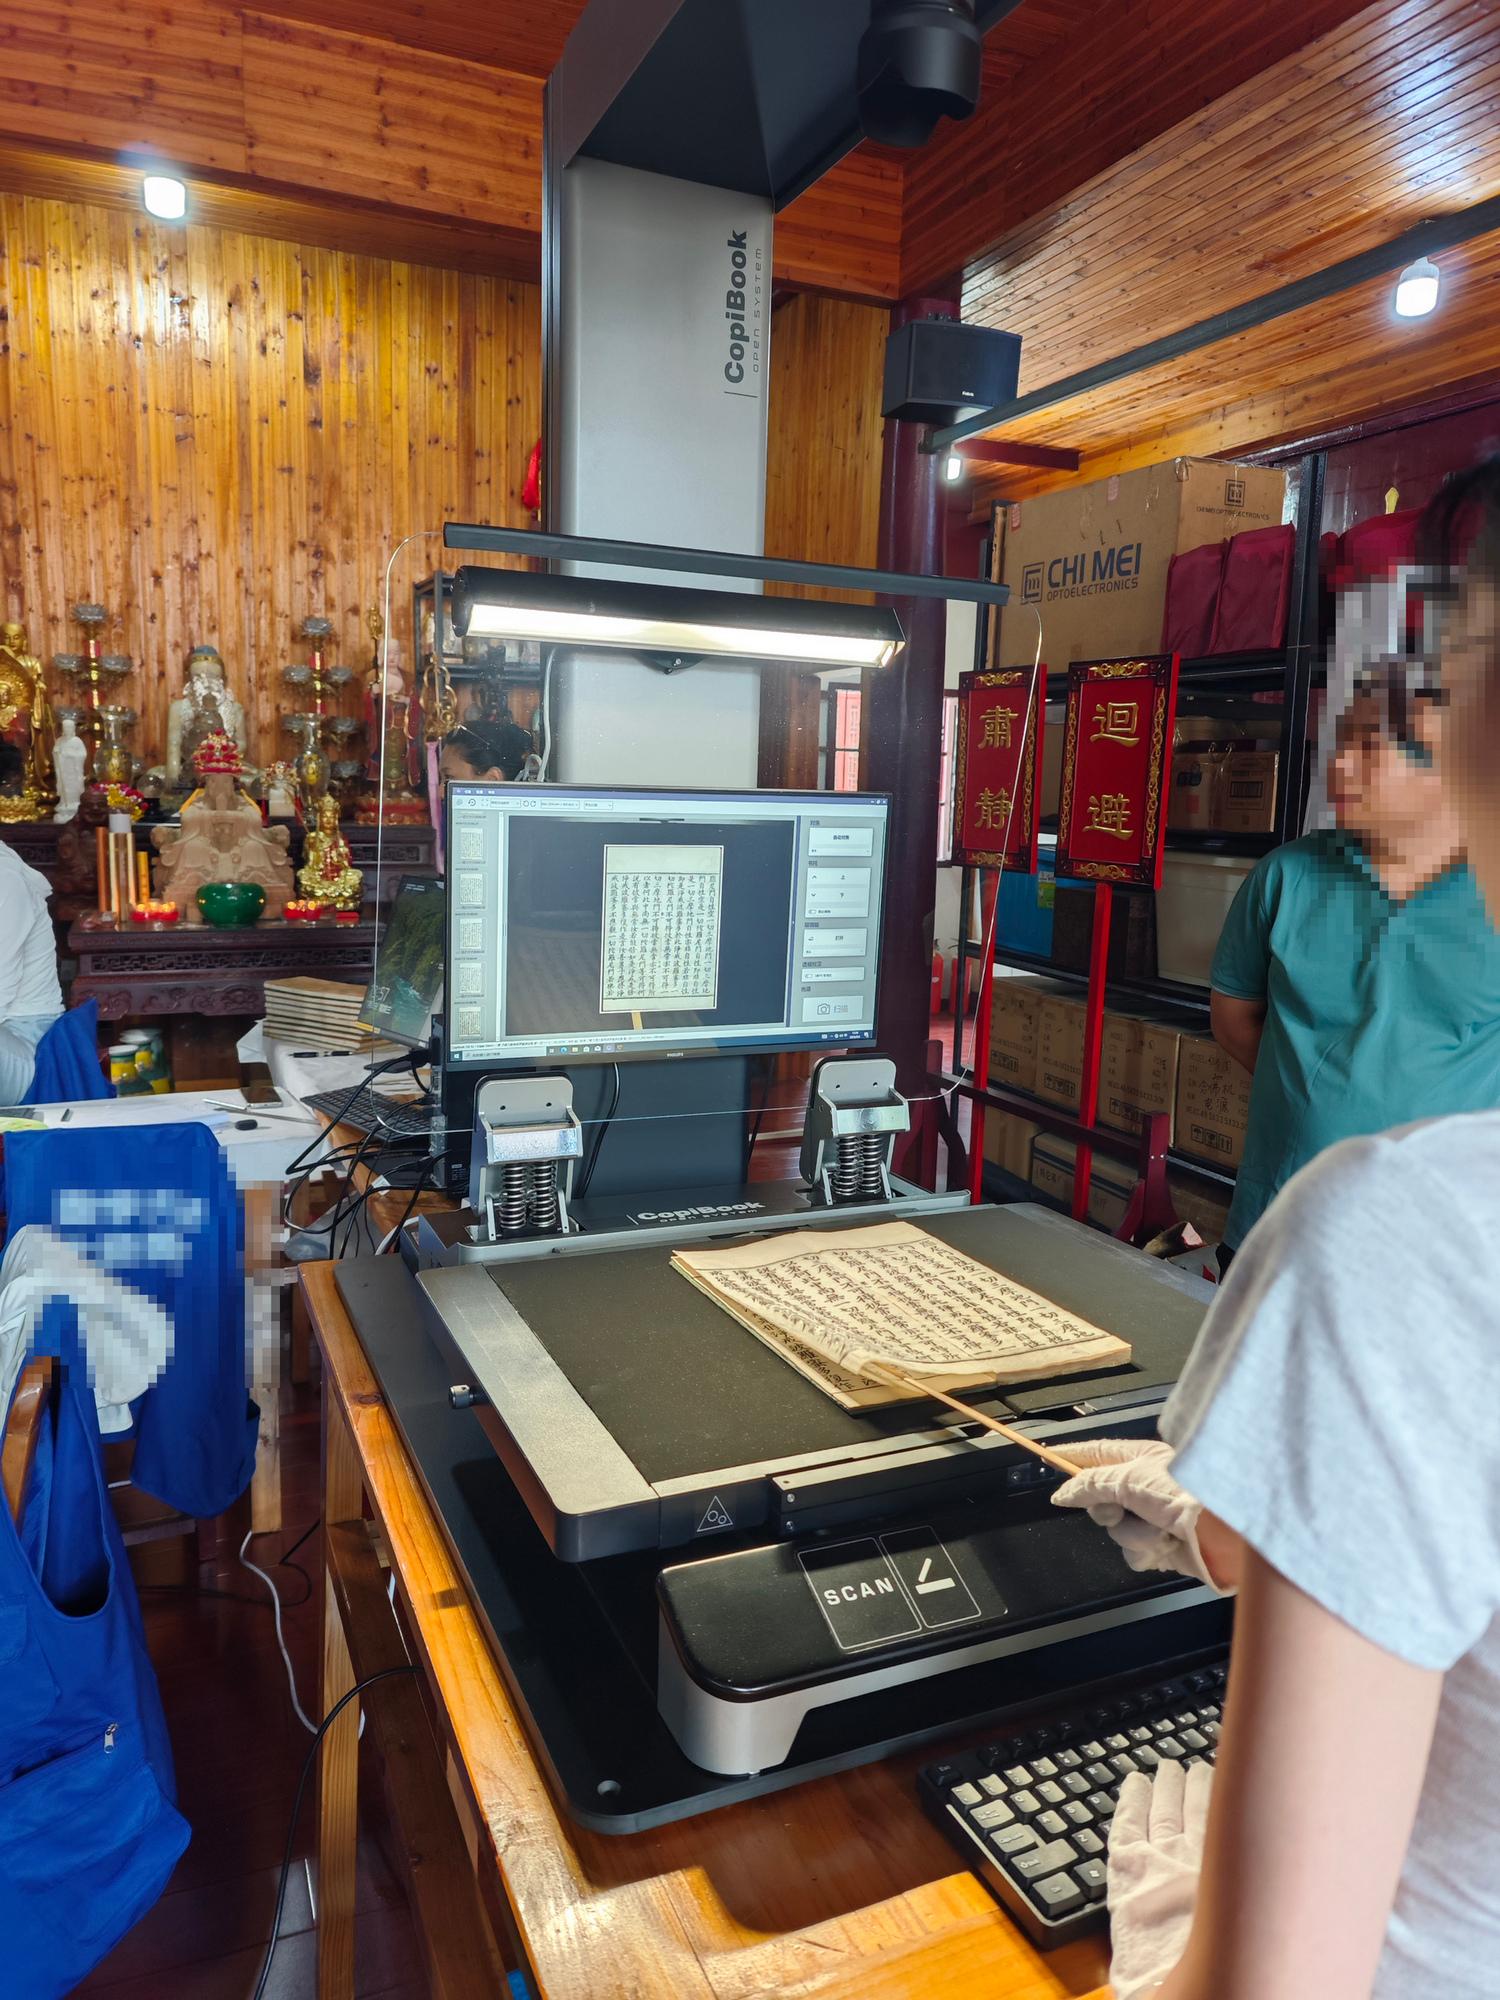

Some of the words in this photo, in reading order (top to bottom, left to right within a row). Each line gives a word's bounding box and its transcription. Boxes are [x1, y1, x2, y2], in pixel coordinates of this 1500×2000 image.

[724, 230, 750, 384] CopiBook
[1048, 552, 1086, 588] CHI
[1091, 543, 1142, 582] MEI
[1046, 577, 1139, 602] OPTOELECTRONICS
[637, 1201, 766, 1220] CopiBook
[823, 1577, 895, 1606] SCAN
